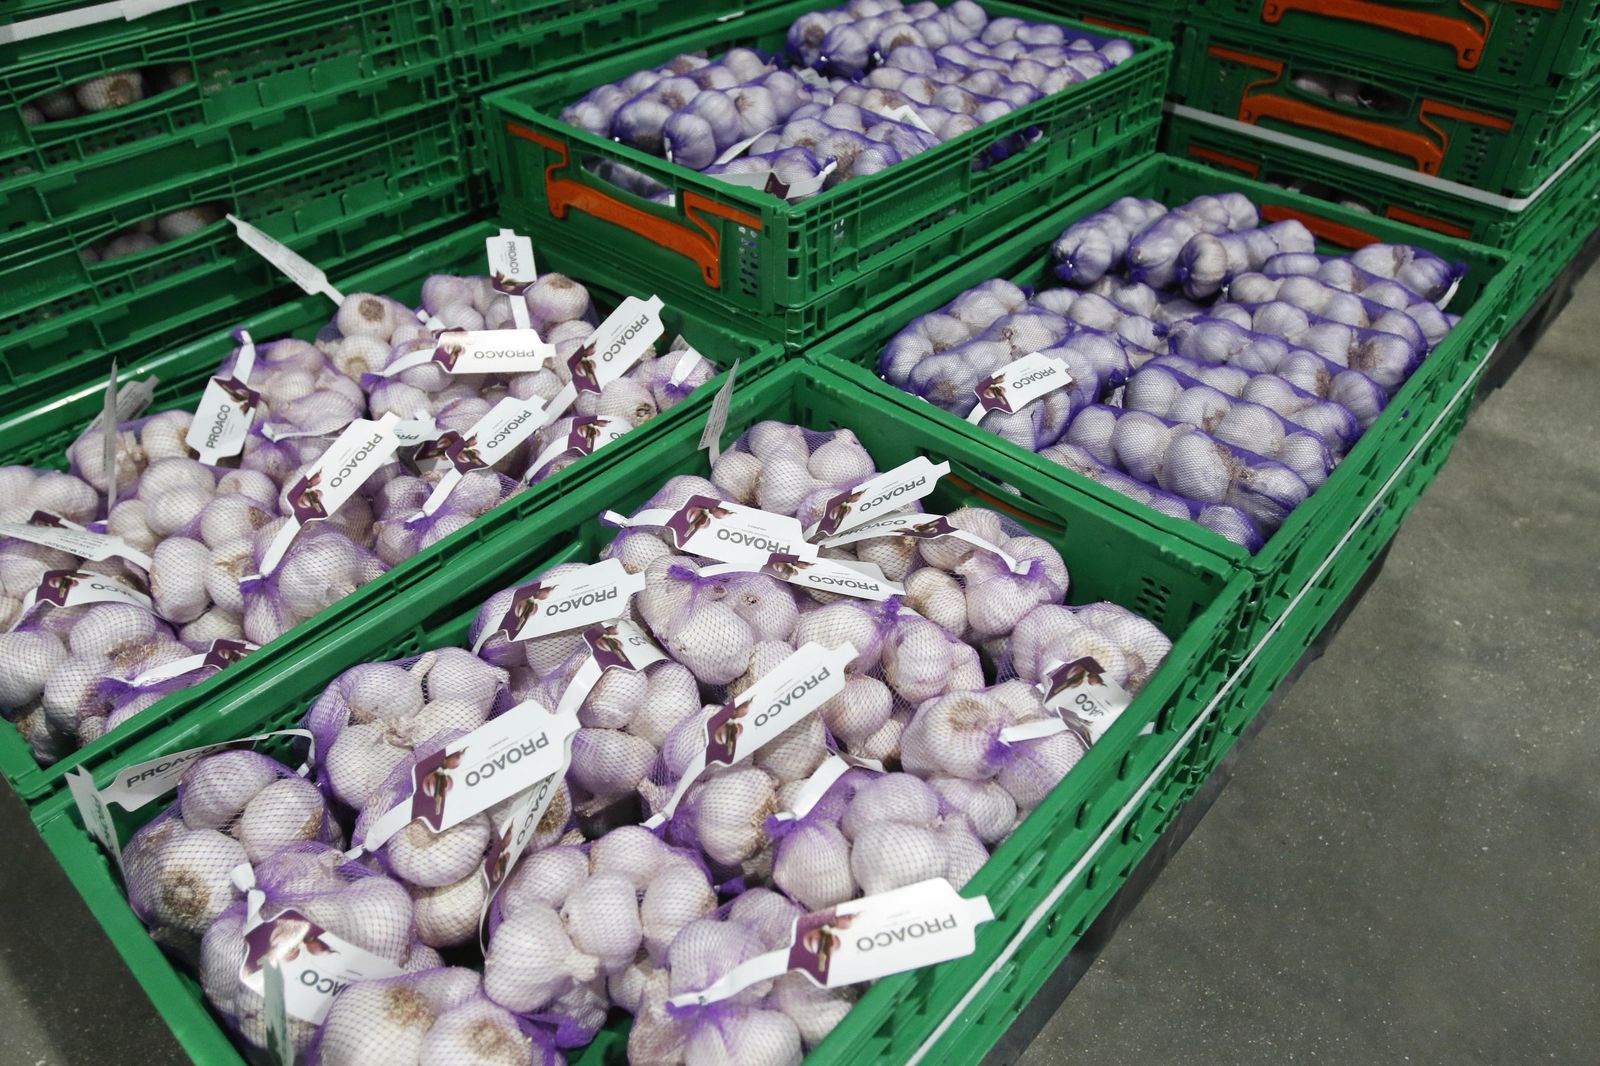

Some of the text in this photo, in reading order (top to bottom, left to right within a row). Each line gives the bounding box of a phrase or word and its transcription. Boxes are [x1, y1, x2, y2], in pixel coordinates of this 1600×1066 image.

[508, 241, 520, 274] PROACO
[474, 350, 534, 360] PROACO
[602, 313, 650, 362] PROACO
[1012, 366, 1056, 389] PROACO
[205, 404, 231, 449] PROACO
[487, 410, 532, 449] PROACO
[330, 433, 383, 488] PROACO
[859, 476, 926, 512] PROACO
[718, 528, 791, 554] PROACO
[546, 586, 618, 616] PROACO
[809, 575, 879, 592] PROACO
[754, 666, 830, 728] PROACO
[127, 746, 216, 788] PROACO
[465, 731, 549, 788] PROACO
[856, 914, 957, 952] PROACO
[300, 970, 352, 996] ACO
